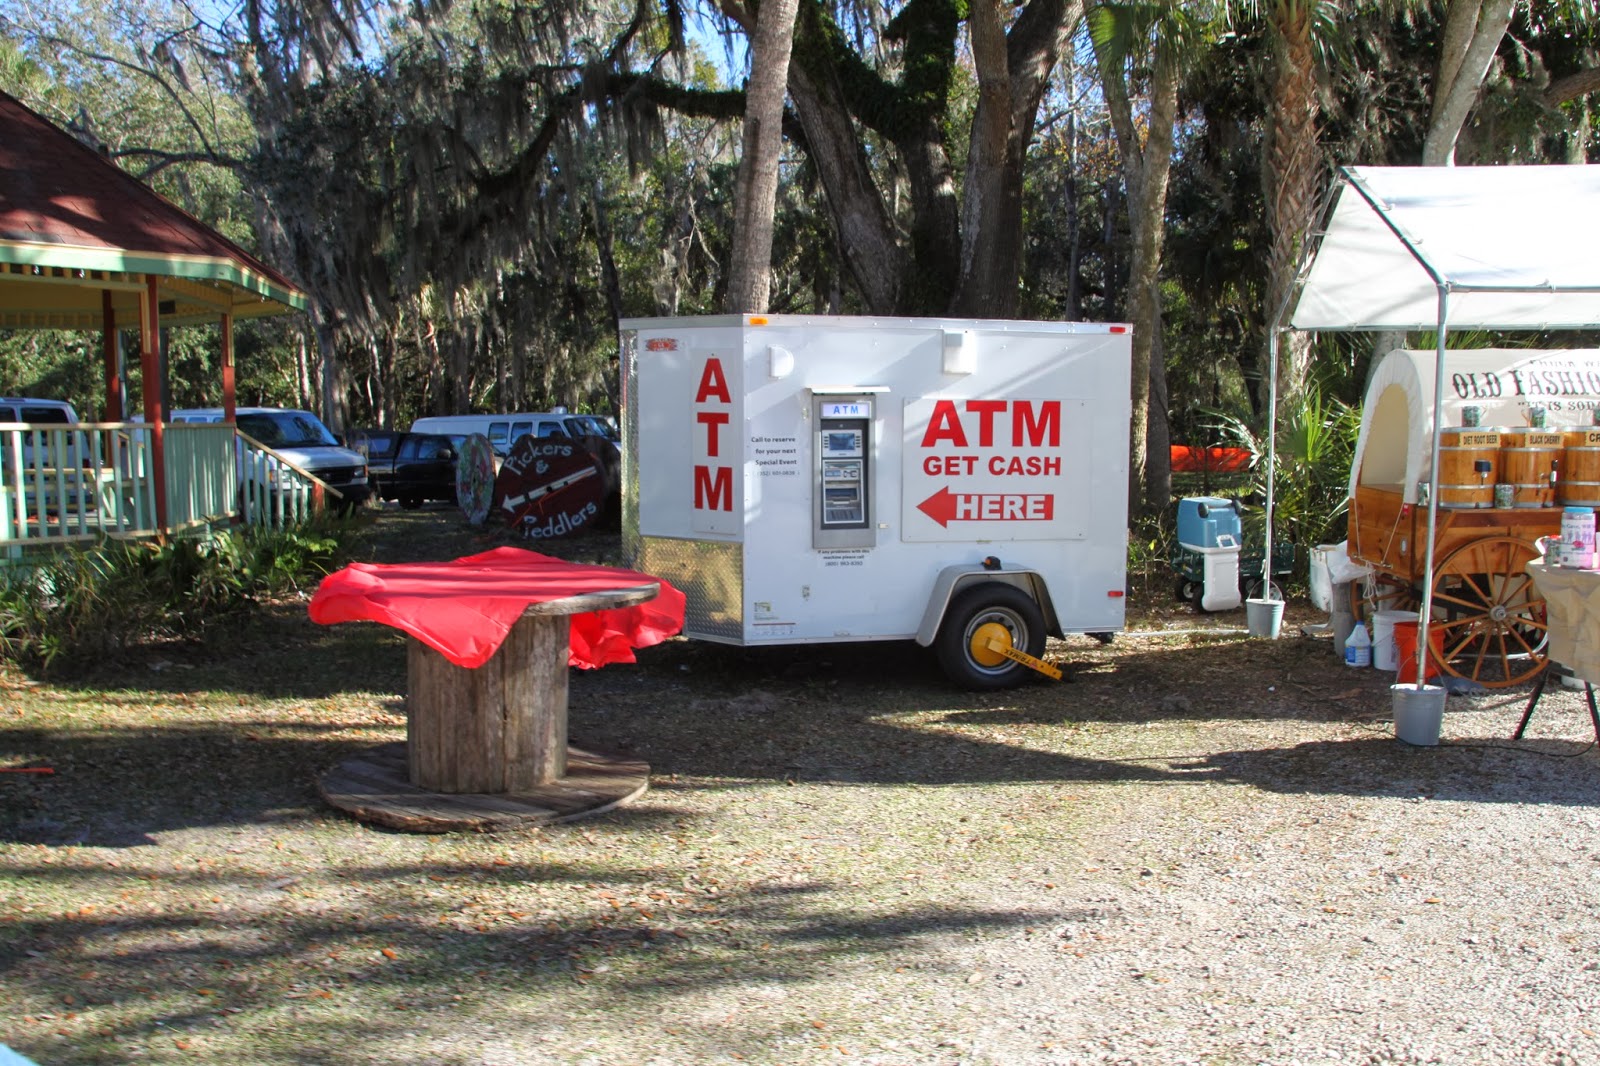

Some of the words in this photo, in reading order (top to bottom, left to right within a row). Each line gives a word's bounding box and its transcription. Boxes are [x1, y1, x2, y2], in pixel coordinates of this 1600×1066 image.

[1452, 372, 1502, 399] OLD
[833, 405, 859, 414] ATM
[1548, 401, 1562, 411] IS
[1568, 401, 1600, 411] SOD
[921, 400, 1061, 447] ATM
[695, 358, 733, 511] ATM
[1463, 436, 1473, 445] DIET
[1474, 435, 1486, 445] ROOT
[1487, 435, 1498, 444] BEER
[1529, 435, 1543, 445] BLACK
[1544, 435, 1561, 445] CHERRY
[504, 440, 573, 476] Pickers
[535, 459, 549, 474] &
[923, 456, 979, 476] GET
[988, 456, 1061, 476] CASH
[956, 495, 1045, 519] HERE
[1005, 648, 1030, 664] TRIMAX
